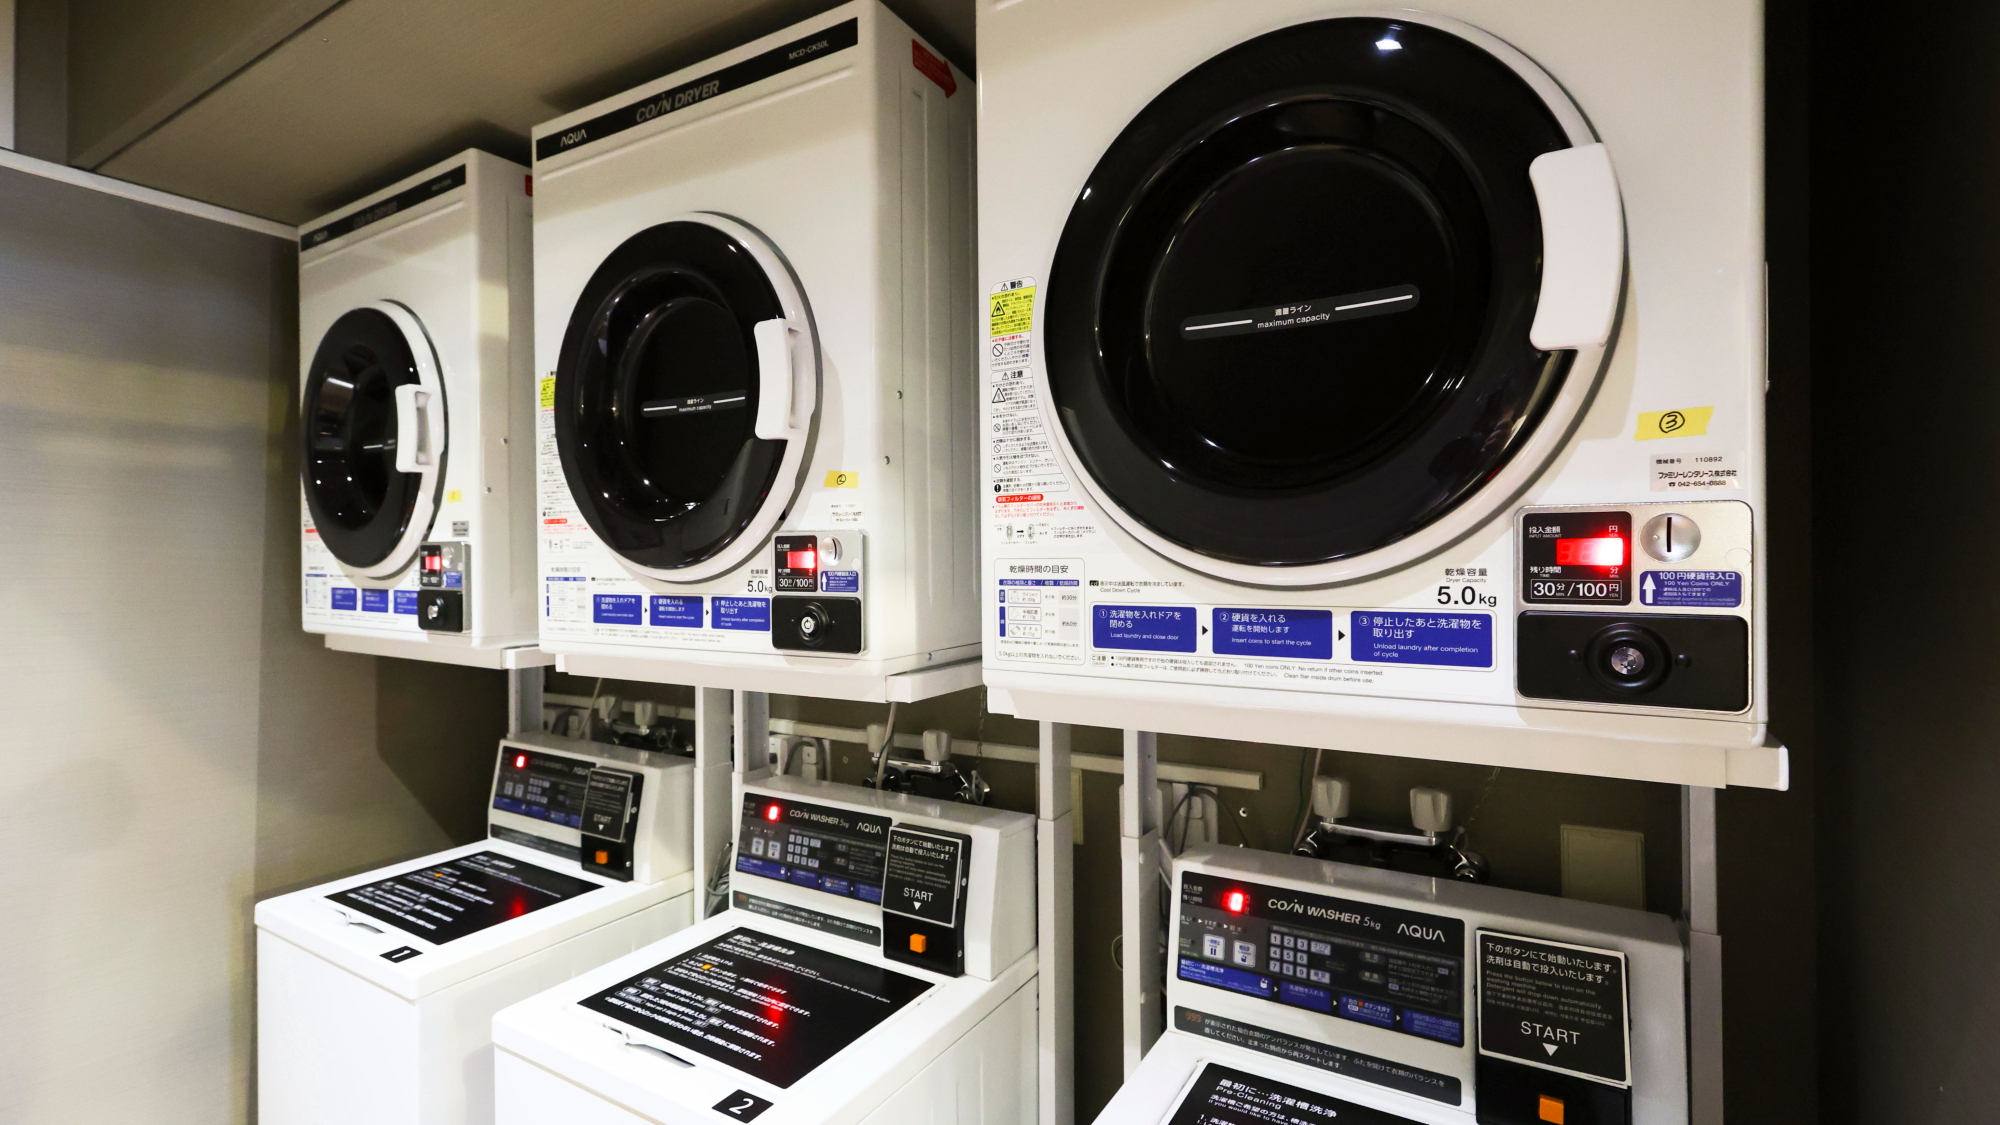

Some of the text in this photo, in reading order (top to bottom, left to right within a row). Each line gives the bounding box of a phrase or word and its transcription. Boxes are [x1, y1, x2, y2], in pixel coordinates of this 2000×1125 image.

[560, 129, 587, 147] AQUA
[675, 80, 719, 107] DRYER
[1257, 312, 1330, 329] maximum capacity
[1529, 526, 1560, 534] 投入金額
[1010, 565, 1069, 573] 乾燥時間の目安
[1445, 568, 1488, 577] 乾燥容量
[1530, 566, 1619, 574] 残り時間 分
[1109, 609, 1181, 620] 洗濯物を入れドアを
[1232, 612, 1286, 623] 硬貨を入れる
[1109, 620, 1133, 629] 閉める
[1232, 625, 1290, 633] 運転を開始します
[1373, 616, 1482, 629] 停止したあと洗濯物を
[1373, 627, 1414, 639] 取り出す
[810, 814, 839, 825] WASHER
[857, 822, 882, 834] AQUA
[903, 887, 933, 902] START
[1230, 892, 1244, 912] 0
[1307, 905, 1361, 924] WASHER
[1363, 917, 1381, 930] 5kg
[1397, 923, 1445, 942] AQUA
[1486, 942, 1617, 974] 下のボタンにて始動いたします。
[1486, 954, 1609, 986] 洗剤は自動で投入いたします。
[1487, 970, 1503, 978] Press
[1535, 979, 1553, 987] below
[1487, 977, 1510, 986] washing
[1487, 982, 1515, 992] Detergent
[1528, 989, 1541, 998] drop
[1520, 1021, 1580, 1045] START
[1215, 1086, 1282, 1110] Pre-Cleaning
[728, 1098, 754, 1115] 2
[1228, 1105, 1248, 1114] would
